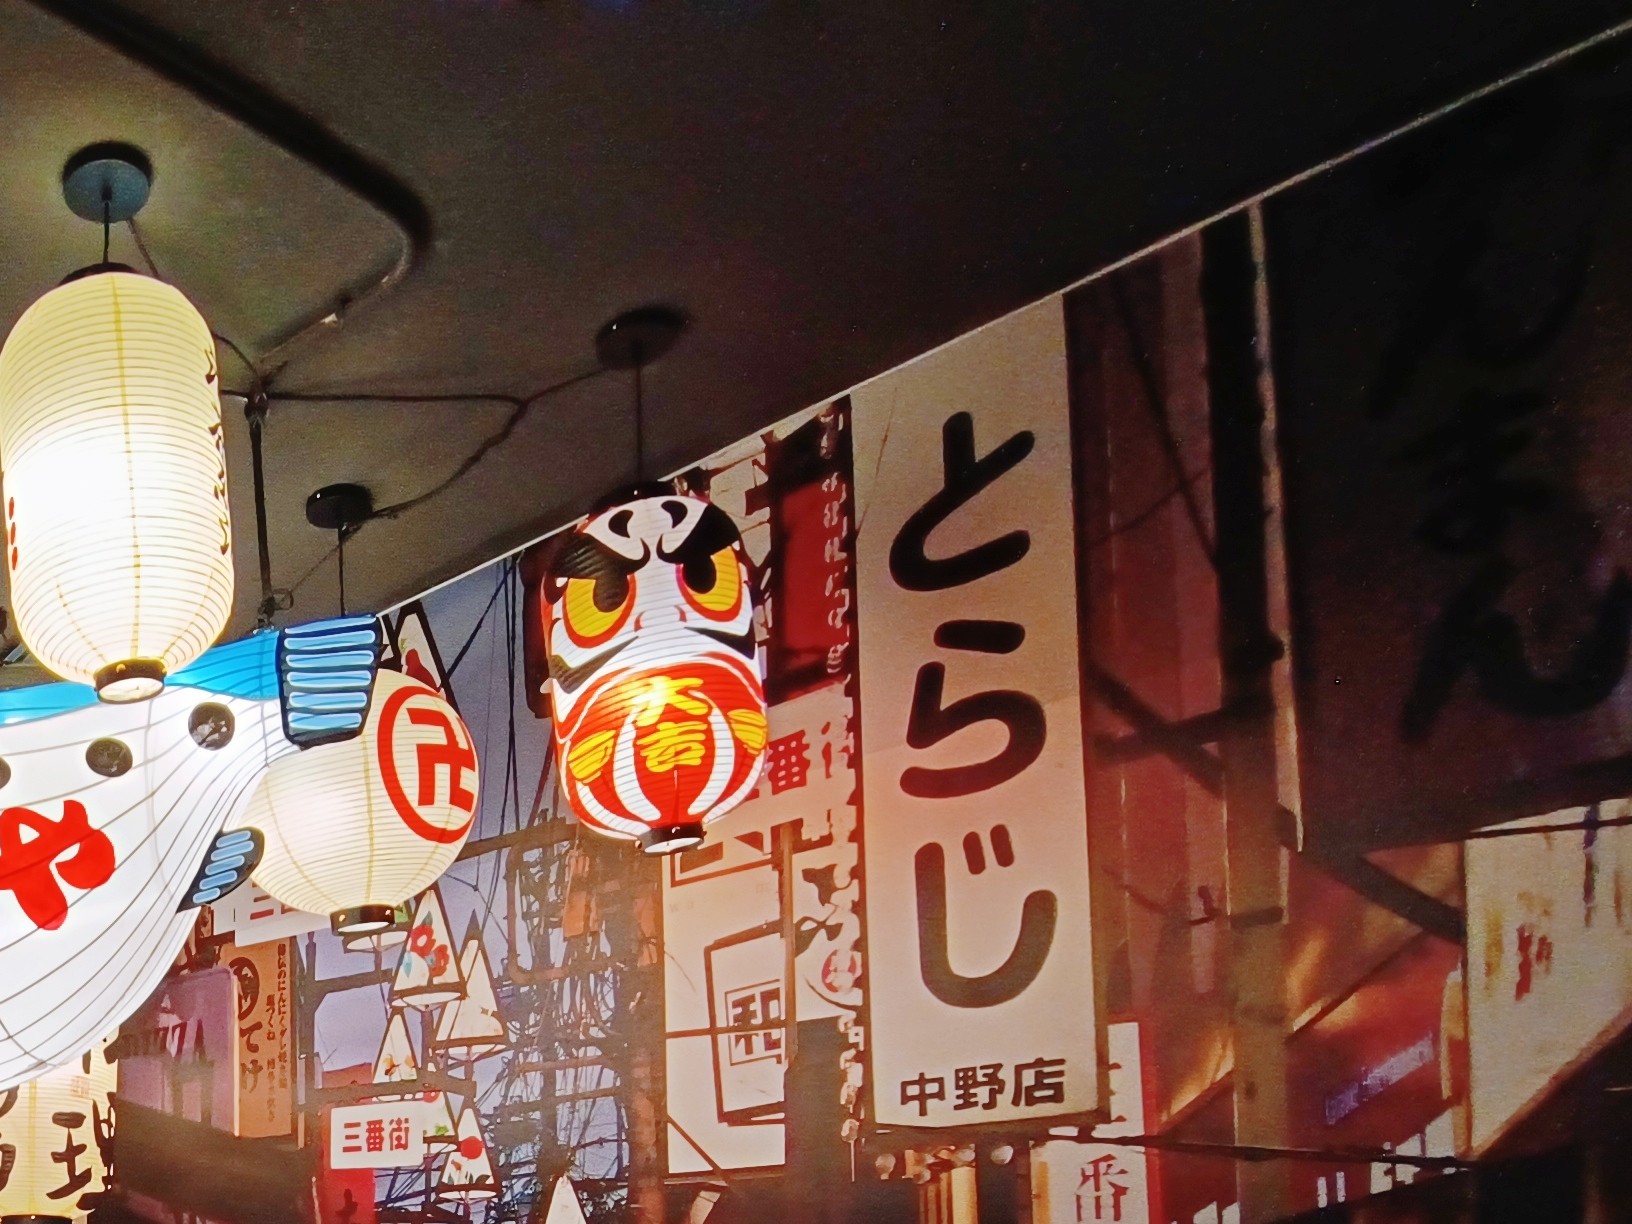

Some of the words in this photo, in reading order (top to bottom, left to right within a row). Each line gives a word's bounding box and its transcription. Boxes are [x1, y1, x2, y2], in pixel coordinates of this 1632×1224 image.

[889, 411, 1058, 1008] とらじ
[900, 1058, 1067, 1116] 中野店
[343, 1118, 409, 1152] 三番街
